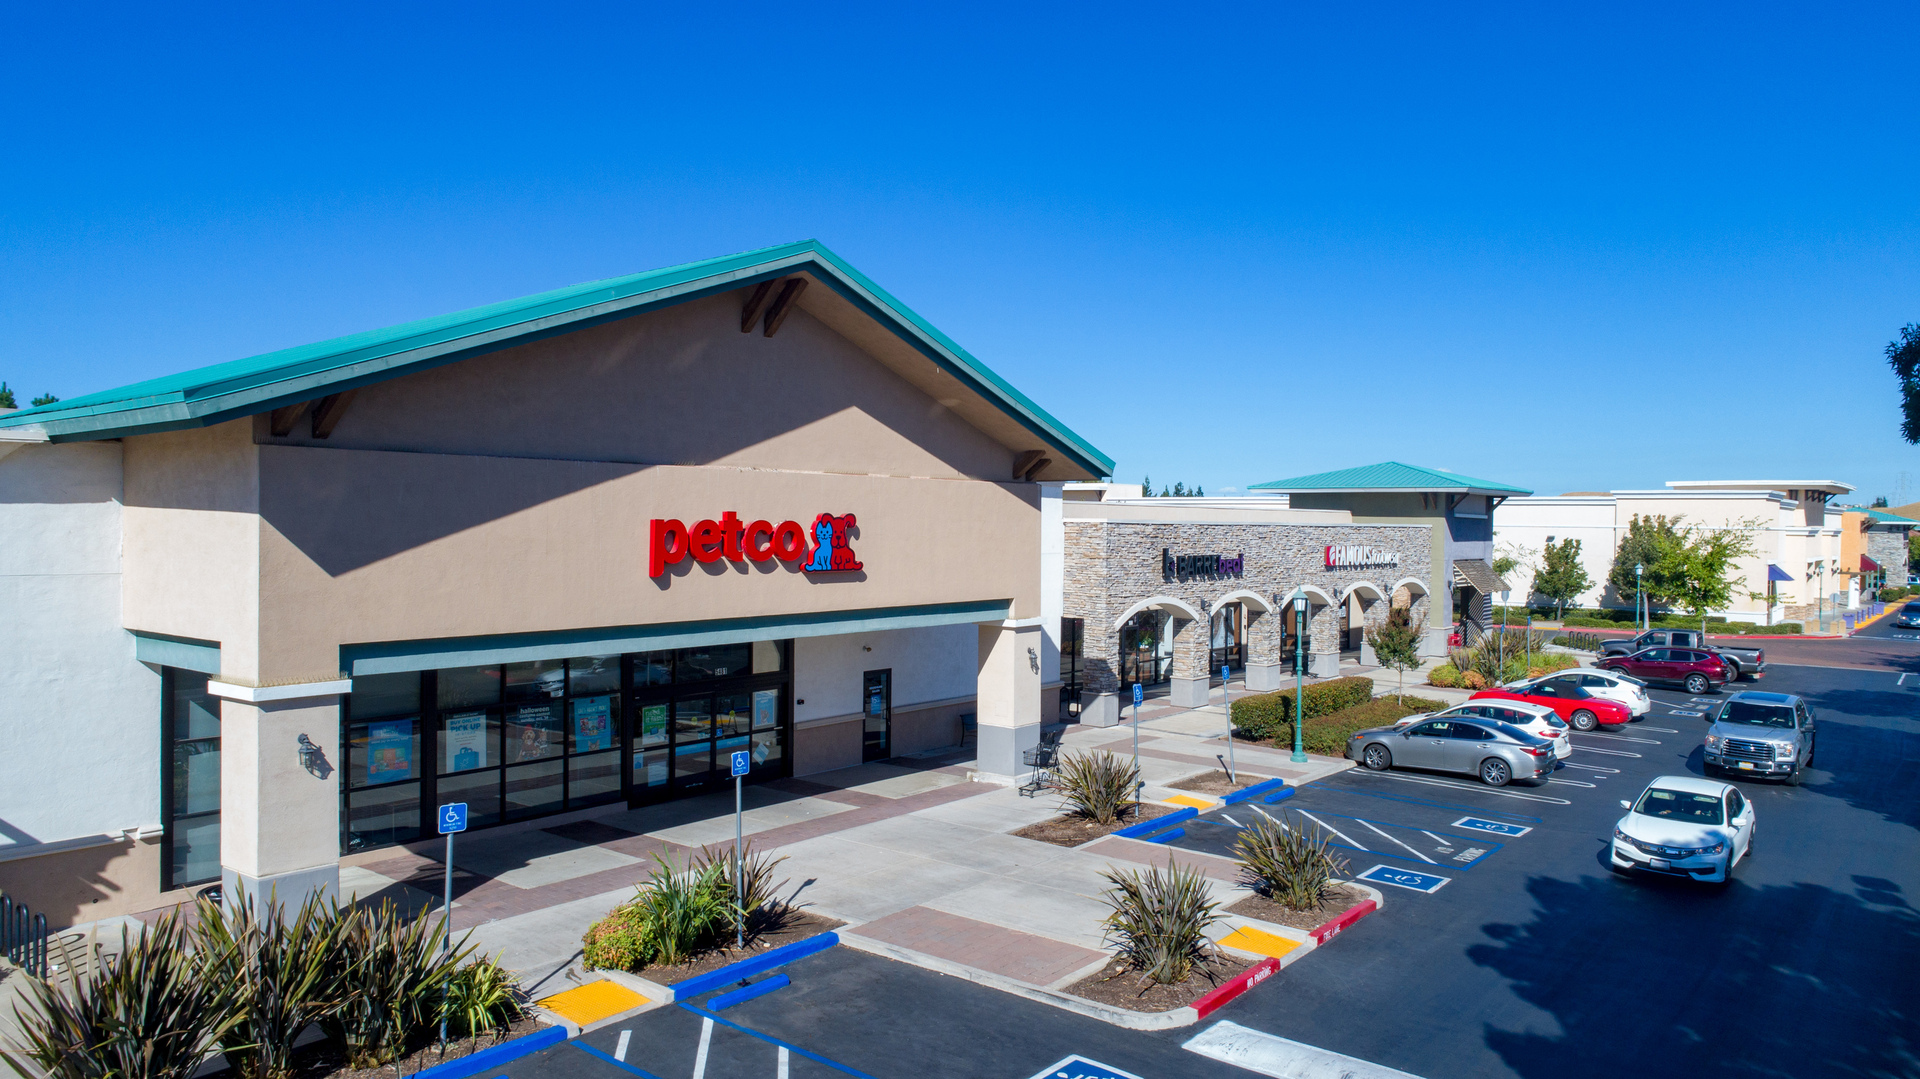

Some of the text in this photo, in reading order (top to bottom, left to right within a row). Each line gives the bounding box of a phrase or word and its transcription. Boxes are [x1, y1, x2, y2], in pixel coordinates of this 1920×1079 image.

[649, 510, 806, 578] petco
[519, 706, 550, 714] halloween
[450, 723, 481, 732] PICK UP
[1246, 966, 1272, 989] NO PARKING
